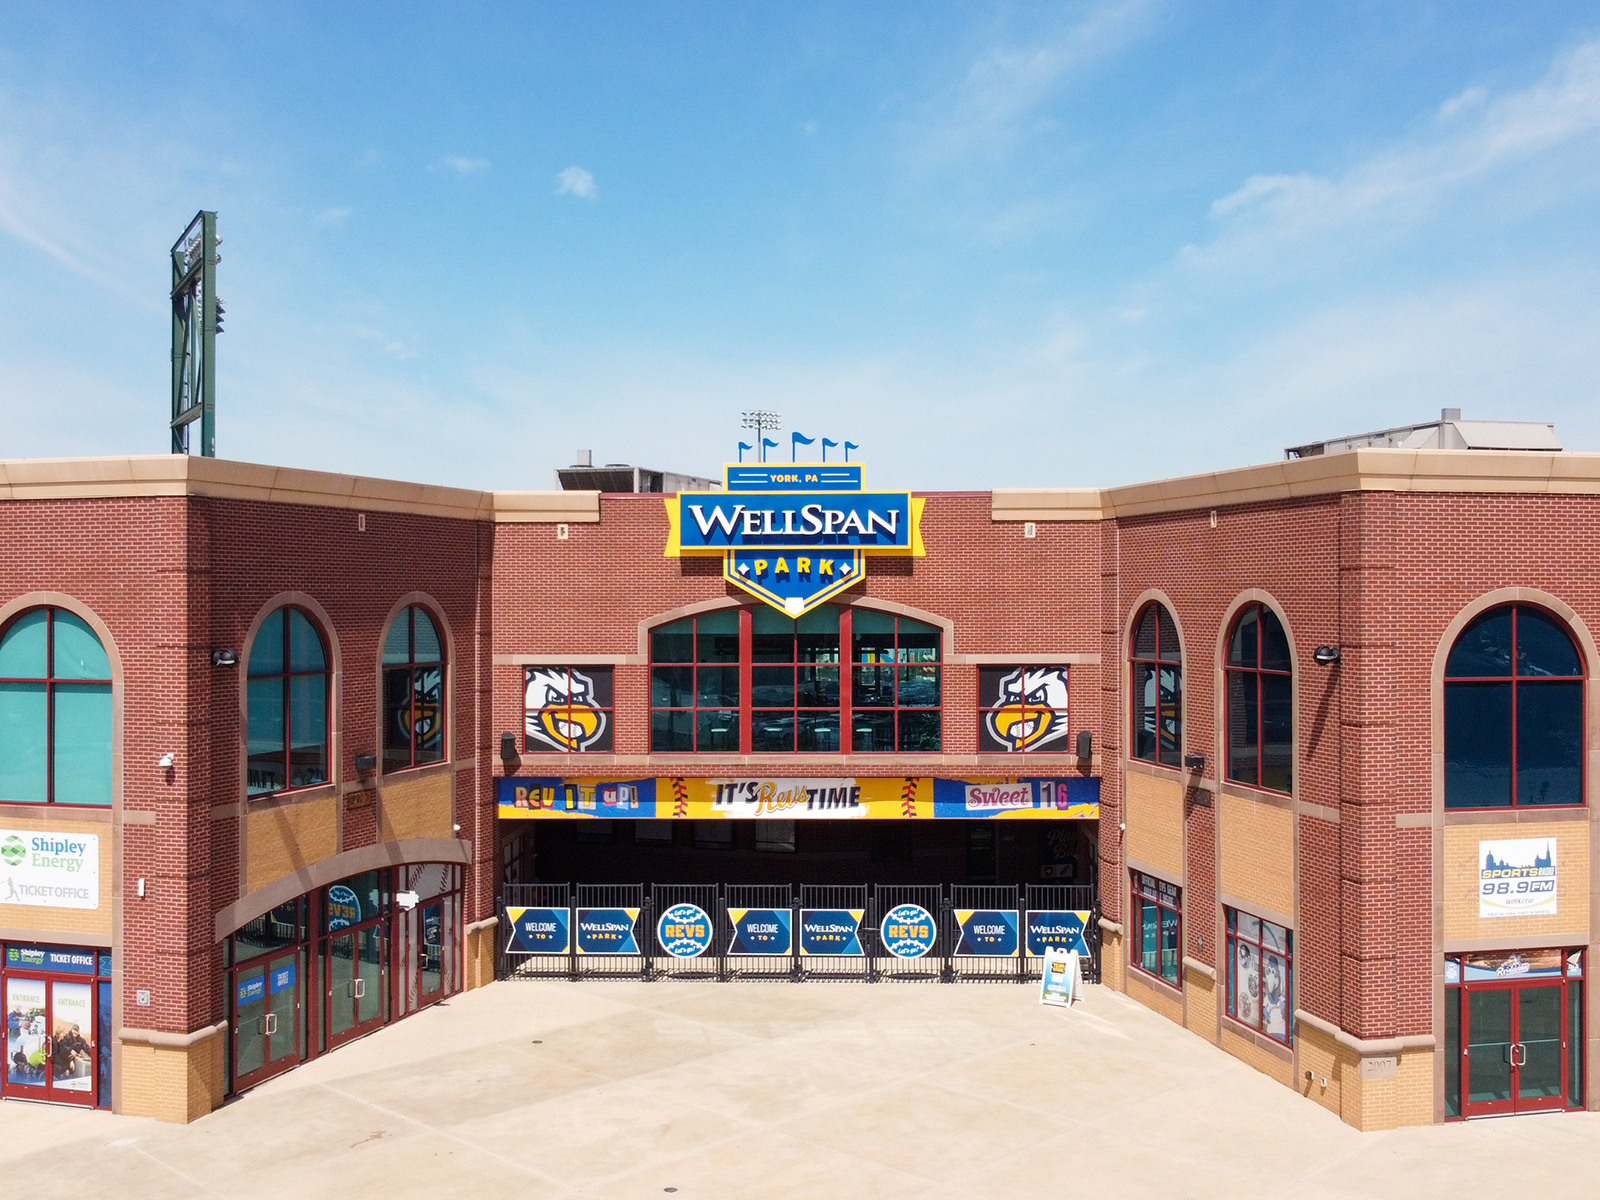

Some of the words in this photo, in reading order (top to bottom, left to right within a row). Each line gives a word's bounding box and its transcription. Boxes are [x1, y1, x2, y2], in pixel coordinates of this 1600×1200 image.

[770, 474, 802, 483] YORK,
[805, 474, 818, 482] PA
[754, 557, 834, 576] PARK
[715, 781, 758, 805] IT'S
[806, 786, 861, 810] TIME
[967, 786, 1029, 808] Sweet
[1042, 781, 1067, 808] 16
[32, 837, 87, 857] Shipley
[32, 853, 84, 873] Energy
[1482, 867, 1539, 879] SPORTS
[19, 884, 54, 897] TICKET
[54, 886, 89, 899] OFFICE
[1482, 881, 1530, 895] 98.9
[1531, 881, 1554, 892] FM
[525, 922, 557, 932] WELCOME
[665, 924, 705, 938] REVS
[747, 924, 779, 933] WELCOME
[888, 924, 929, 938] REVS
[973, 925, 1005, 935] WELCOME
[21, 949, 45, 958] Shipley
[50, 953, 71, 963] TICKET
[71, 955, 93, 966] OFFICE
[21, 955, 44, 965] Energy
[12, 994, 40, 1003] ENTRANCE
[58, 998, 86, 1008] ENTRANCE
[1368, 1060, 1391, 1072] 2007
